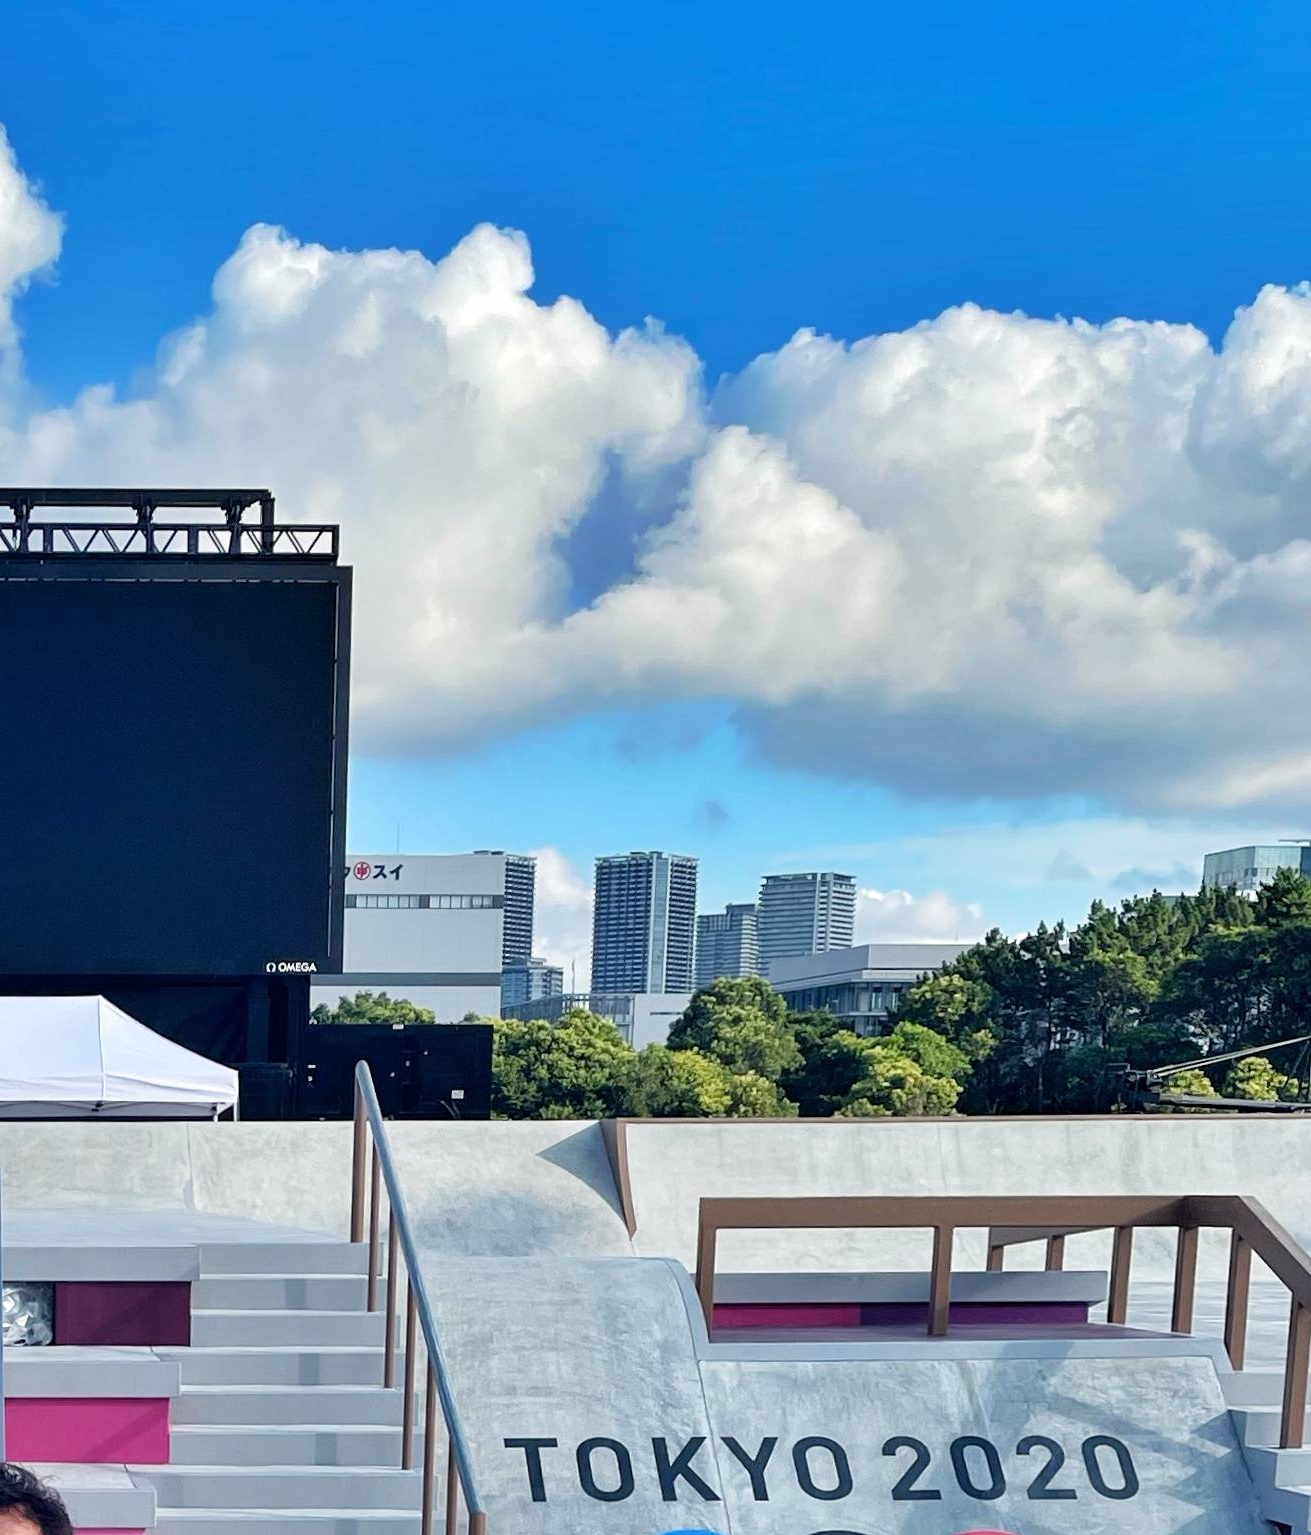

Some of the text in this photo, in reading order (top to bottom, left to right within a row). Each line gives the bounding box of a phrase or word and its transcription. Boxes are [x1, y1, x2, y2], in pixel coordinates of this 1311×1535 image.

[278, 961, 318, 973] OMEGA
[503, 1435, 1141, 1503] TOKYO 2020
